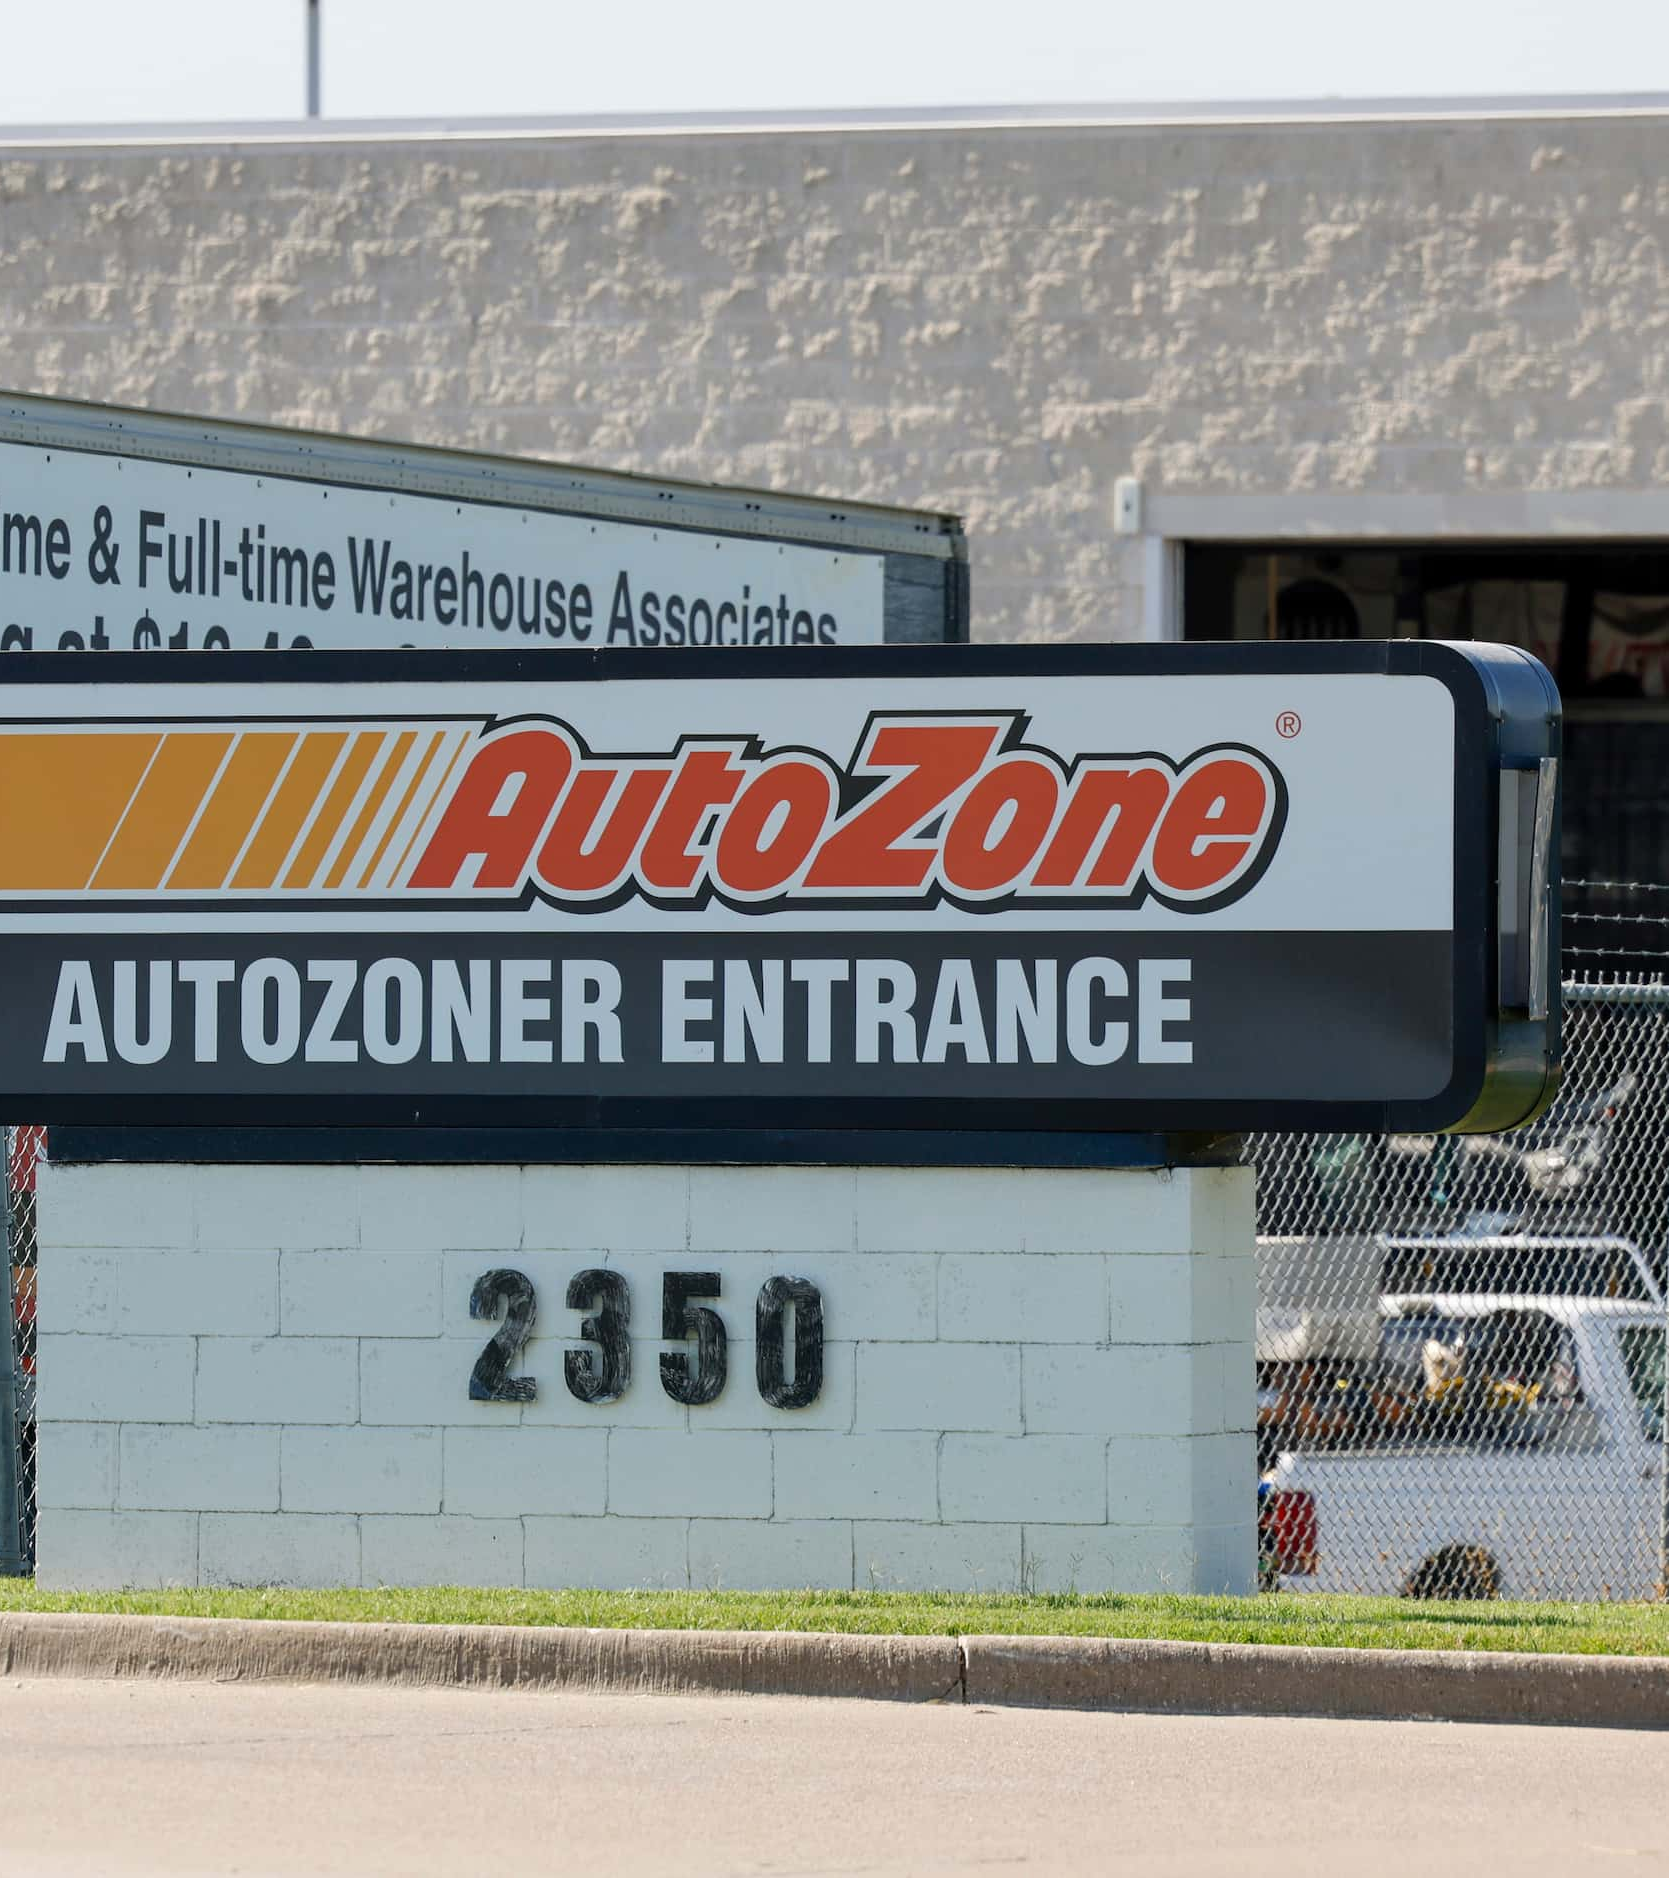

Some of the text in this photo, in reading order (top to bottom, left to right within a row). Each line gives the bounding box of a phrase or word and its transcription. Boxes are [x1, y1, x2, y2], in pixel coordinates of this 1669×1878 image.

[89, 505, 121, 585] &
[139, 510, 336, 610] Full-time
[348, 537, 593, 642] Warehouse
[606, 570, 837, 645] Associates
[406, 725, 1265, 892] AutoZone
[42, 956, 1194, 1066] AUTOZONER ENTRANCE
[468, 1268, 825, 1410] 2350
